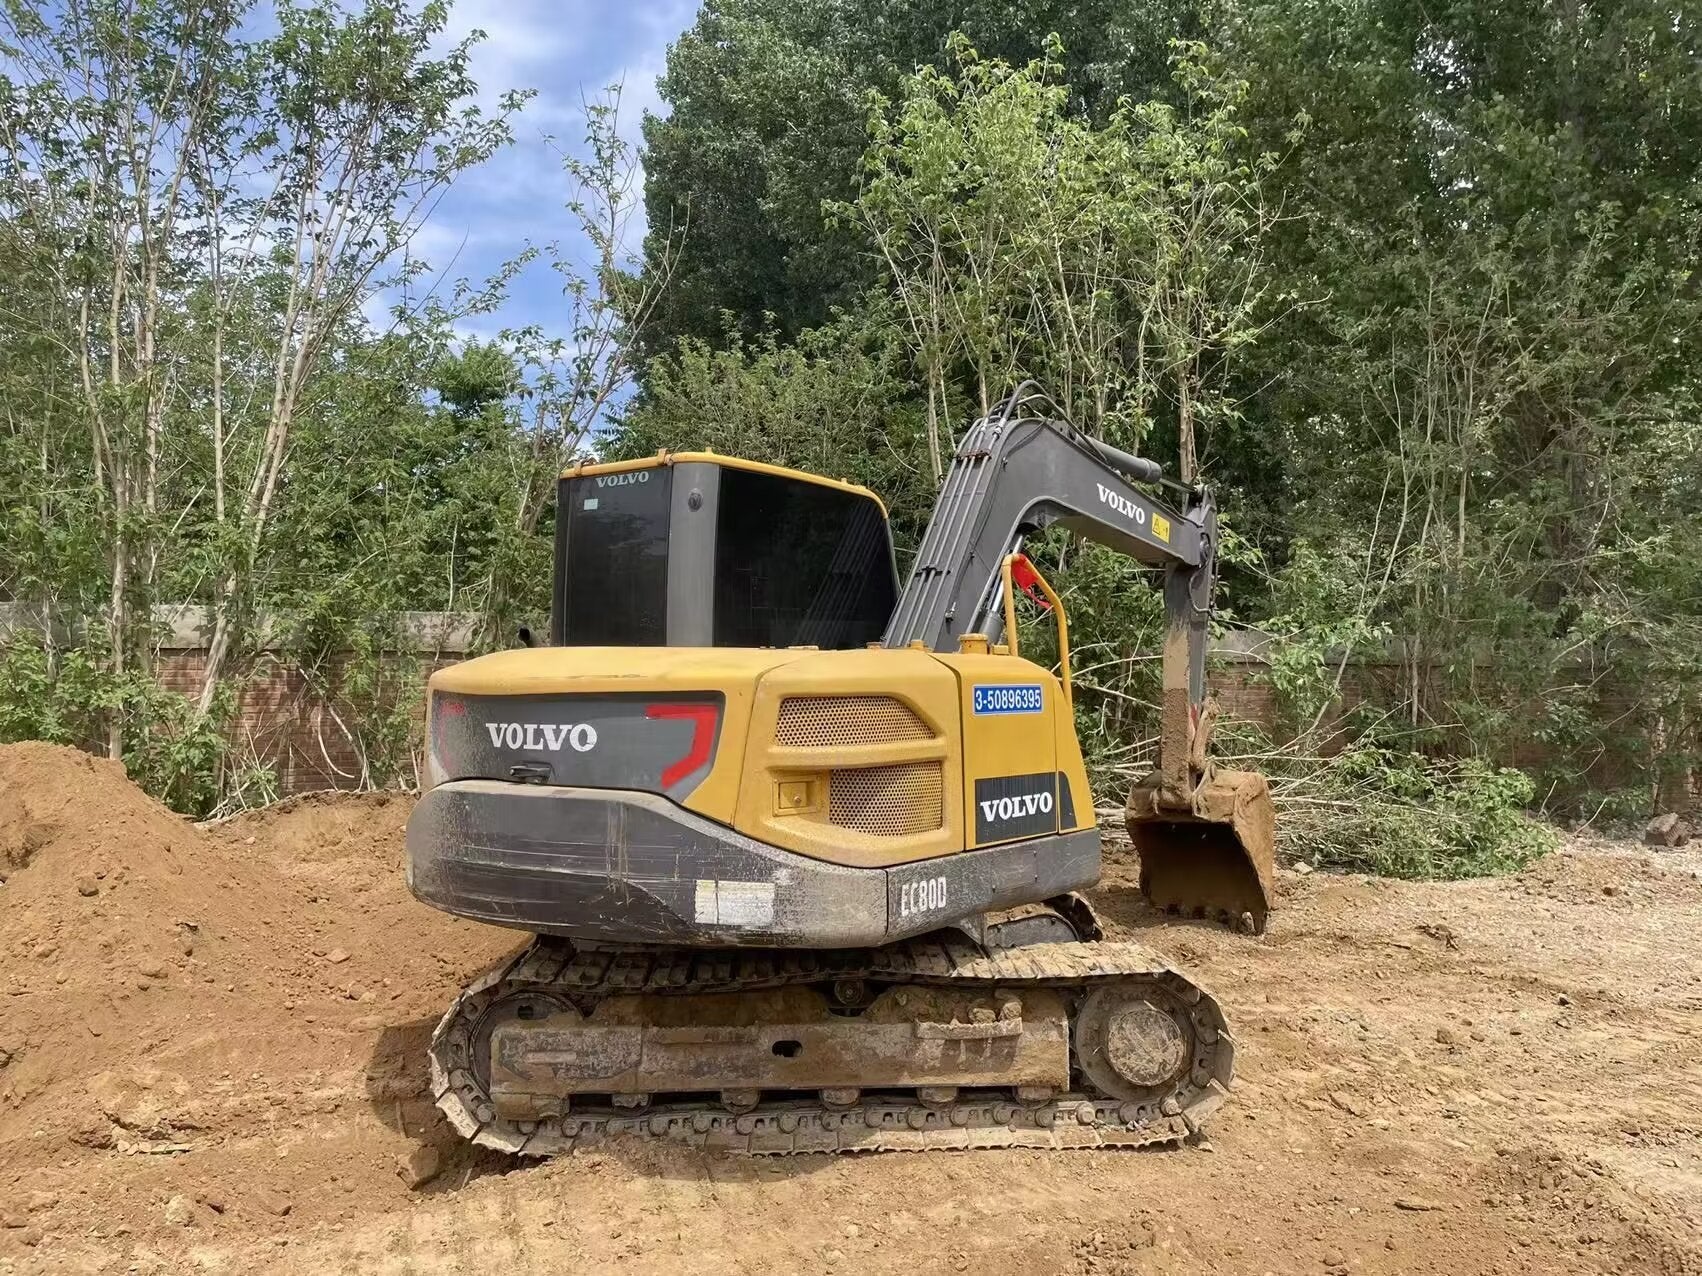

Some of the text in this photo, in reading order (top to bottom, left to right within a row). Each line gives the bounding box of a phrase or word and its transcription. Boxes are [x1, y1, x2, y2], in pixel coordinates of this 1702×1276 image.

[595, 471, 649, 488] VOLVO
[1096, 482, 1146, 525] VOLVO
[975, 689, 1041, 711] 3-50896395
[485, 722, 598, 752] VOLVO
[980, 791, 1053, 822] VOLVO
[901, 876, 947, 917] EC80D
